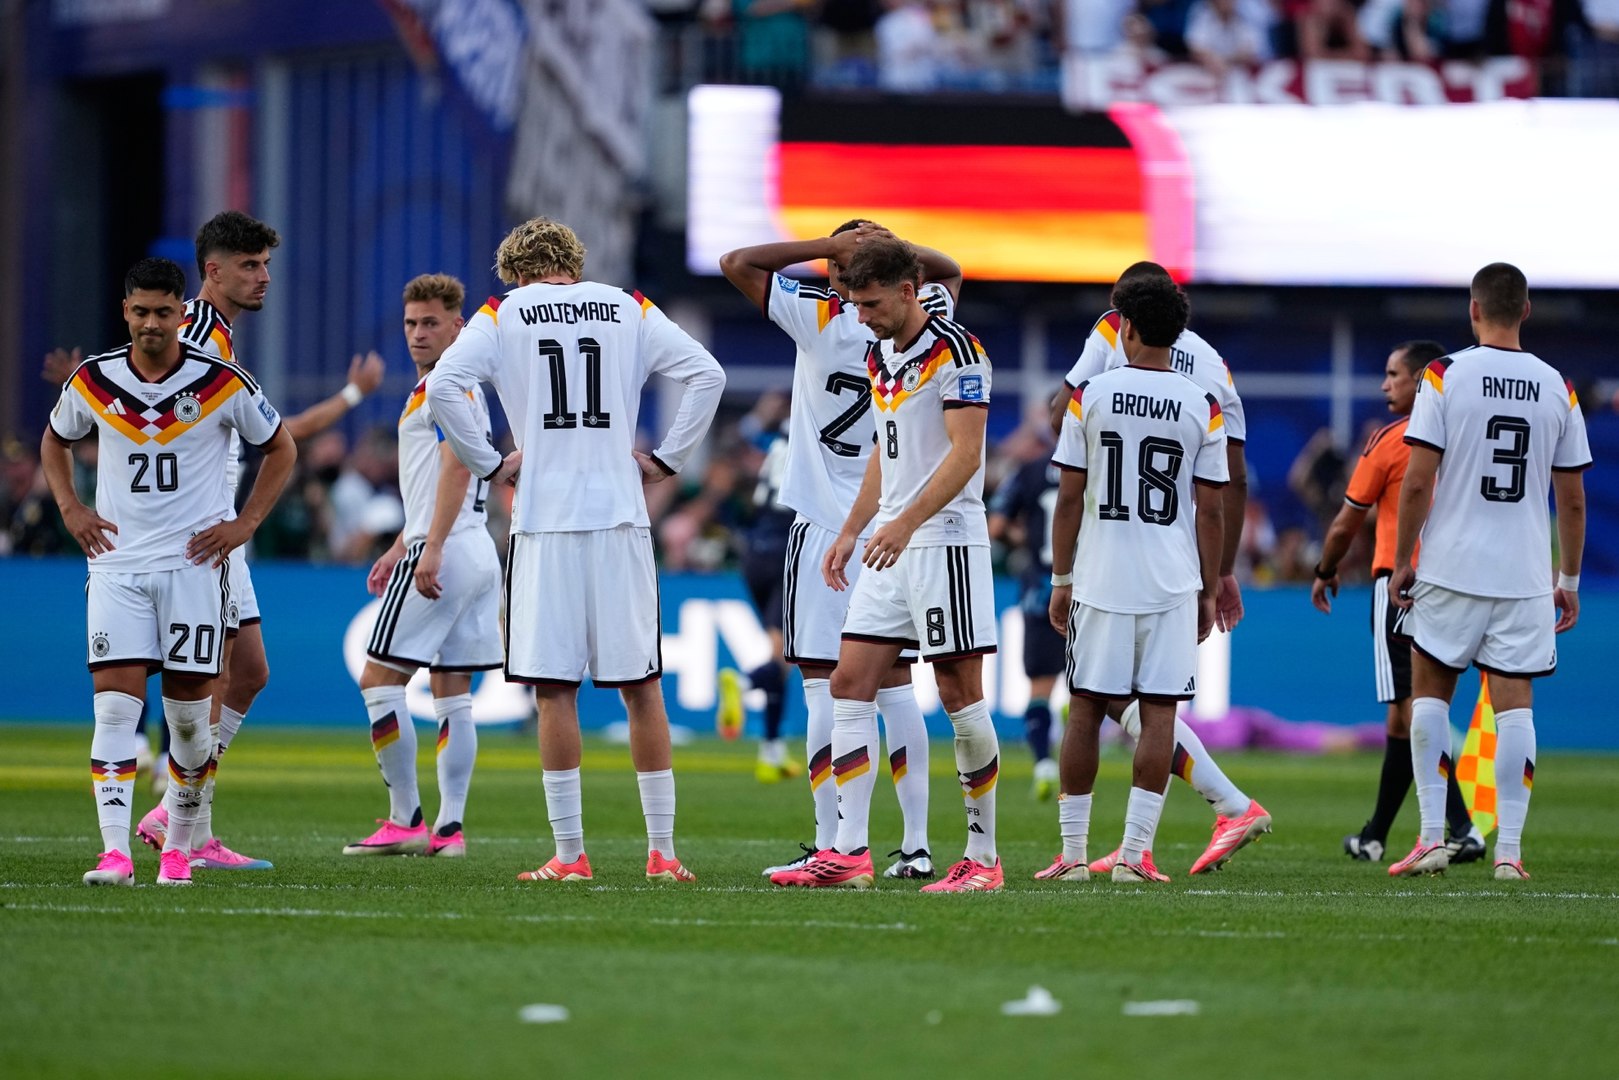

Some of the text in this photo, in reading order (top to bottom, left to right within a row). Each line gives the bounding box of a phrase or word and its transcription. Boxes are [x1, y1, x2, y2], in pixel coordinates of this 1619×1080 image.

[519, 302, 621, 326] WOLTEMADE
[1170, 346, 1194, 375] TAH
[539, 338, 610, 429] 11
[1483, 377, 1540, 402] ANTON
[820, 371, 879, 457] 2
[1112, 393, 1182, 422] BROWN
[886, 421, 898, 459] 8
[1480, 415, 1530, 503] 3
[128, 453, 178, 493] 20
[1099, 431, 1184, 526] 18
[168, 623, 214, 664] 20
[926, 607, 946, 647] 8
